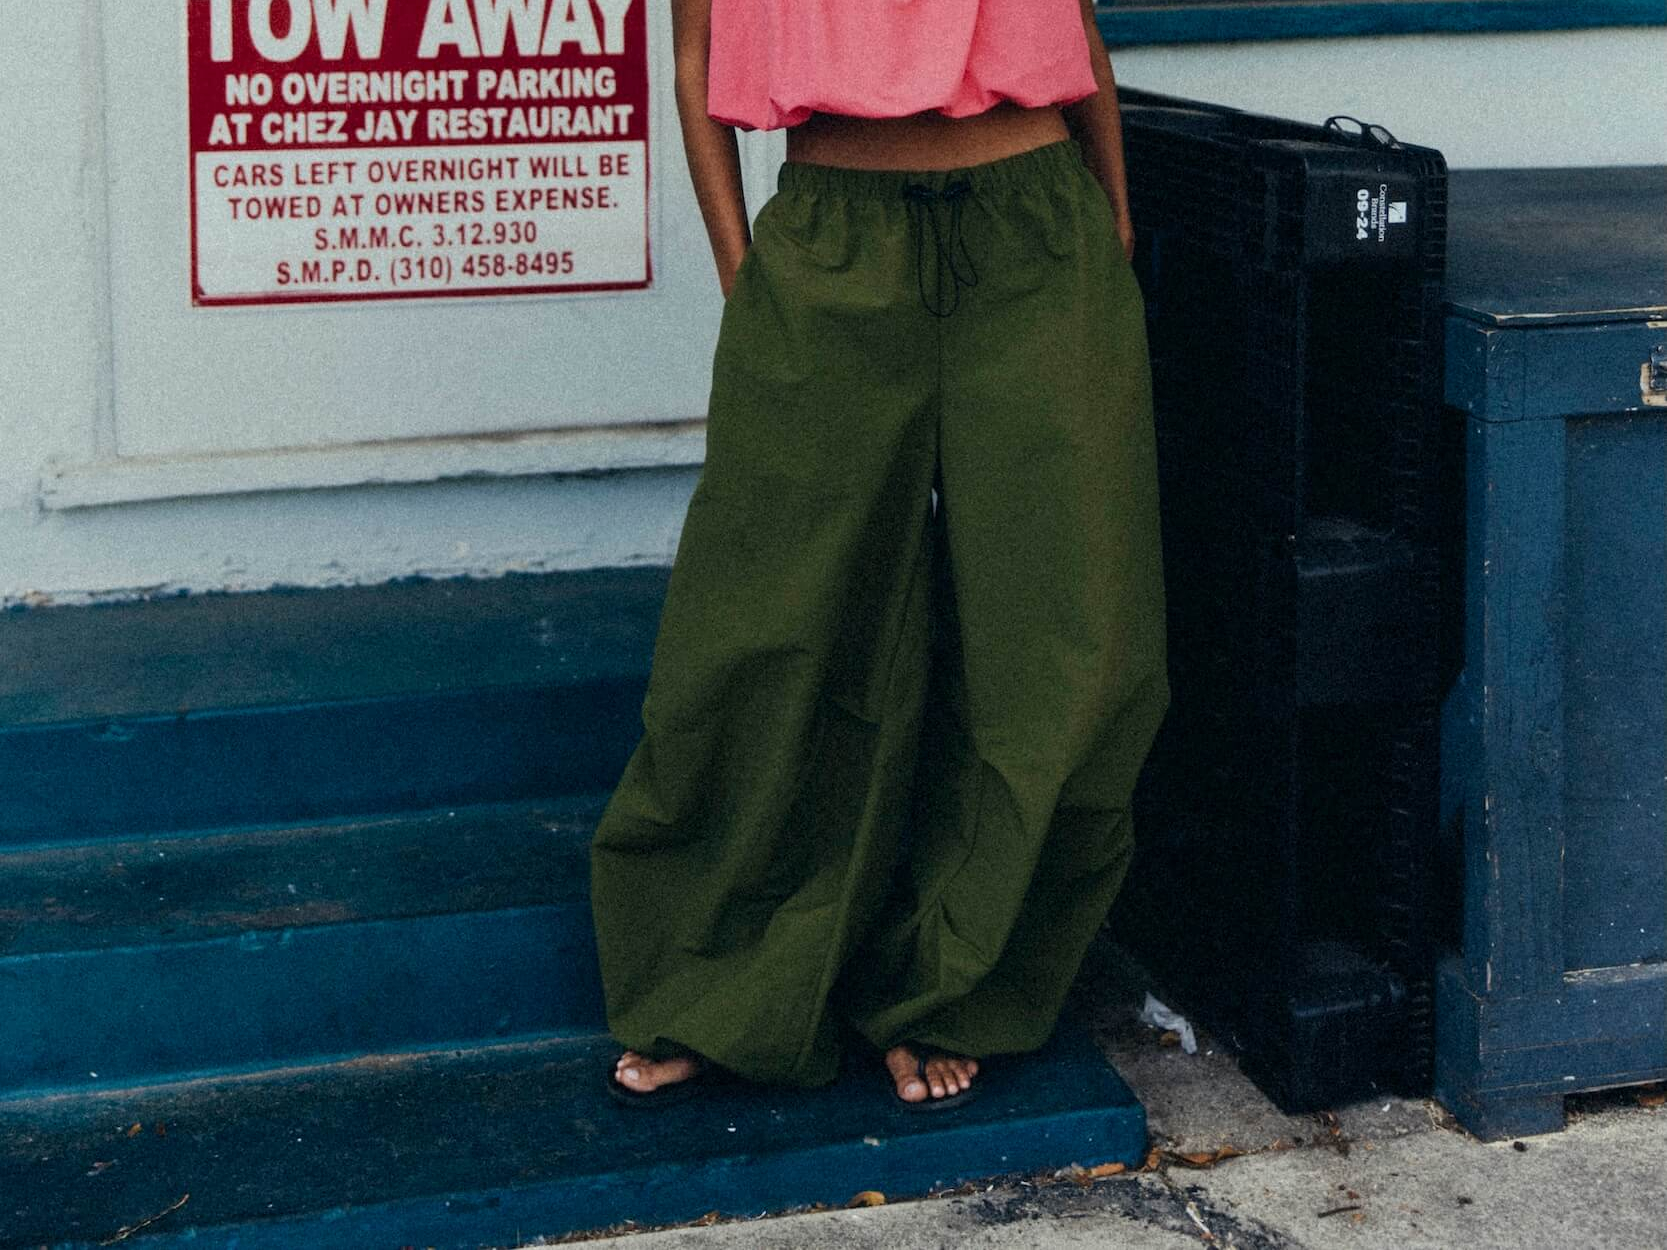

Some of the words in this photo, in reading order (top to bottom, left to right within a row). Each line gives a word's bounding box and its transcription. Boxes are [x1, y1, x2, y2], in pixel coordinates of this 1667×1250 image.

[226, 74, 272, 105] NO
[282, 70, 468, 103] OVERNIGHT
[478, 68, 615, 99] PARKING
[209, 114, 253, 144] AT
[261, 112, 348, 143] CHEZ
[357, 110, 419, 141] JAY
[428, 105, 633, 138] RESTAURANT
[214, 163, 283, 188] CARS
[295, 162, 356, 185] LEFT
[368, 157, 519, 183] OVERNIGHT
[529, 156, 588, 178] WILL
[600, 154, 629, 176] BE
[228, 195, 321, 219] TOWED
[332, 195, 363, 216] AT
[375, 190, 485, 215] OWNERS
[498, 186, 618, 211] EXPENSE.
[1378, 184, 1387, 242] Constellation
[315, 224, 422, 250] S.M.M.C.
[433, 221, 537, 246] 3.12.930
[277, 259, 380, 285] S.M.P.D.
[391, 257, 452, 285] (310)
[462, 252, 573, 277] 458-8495
